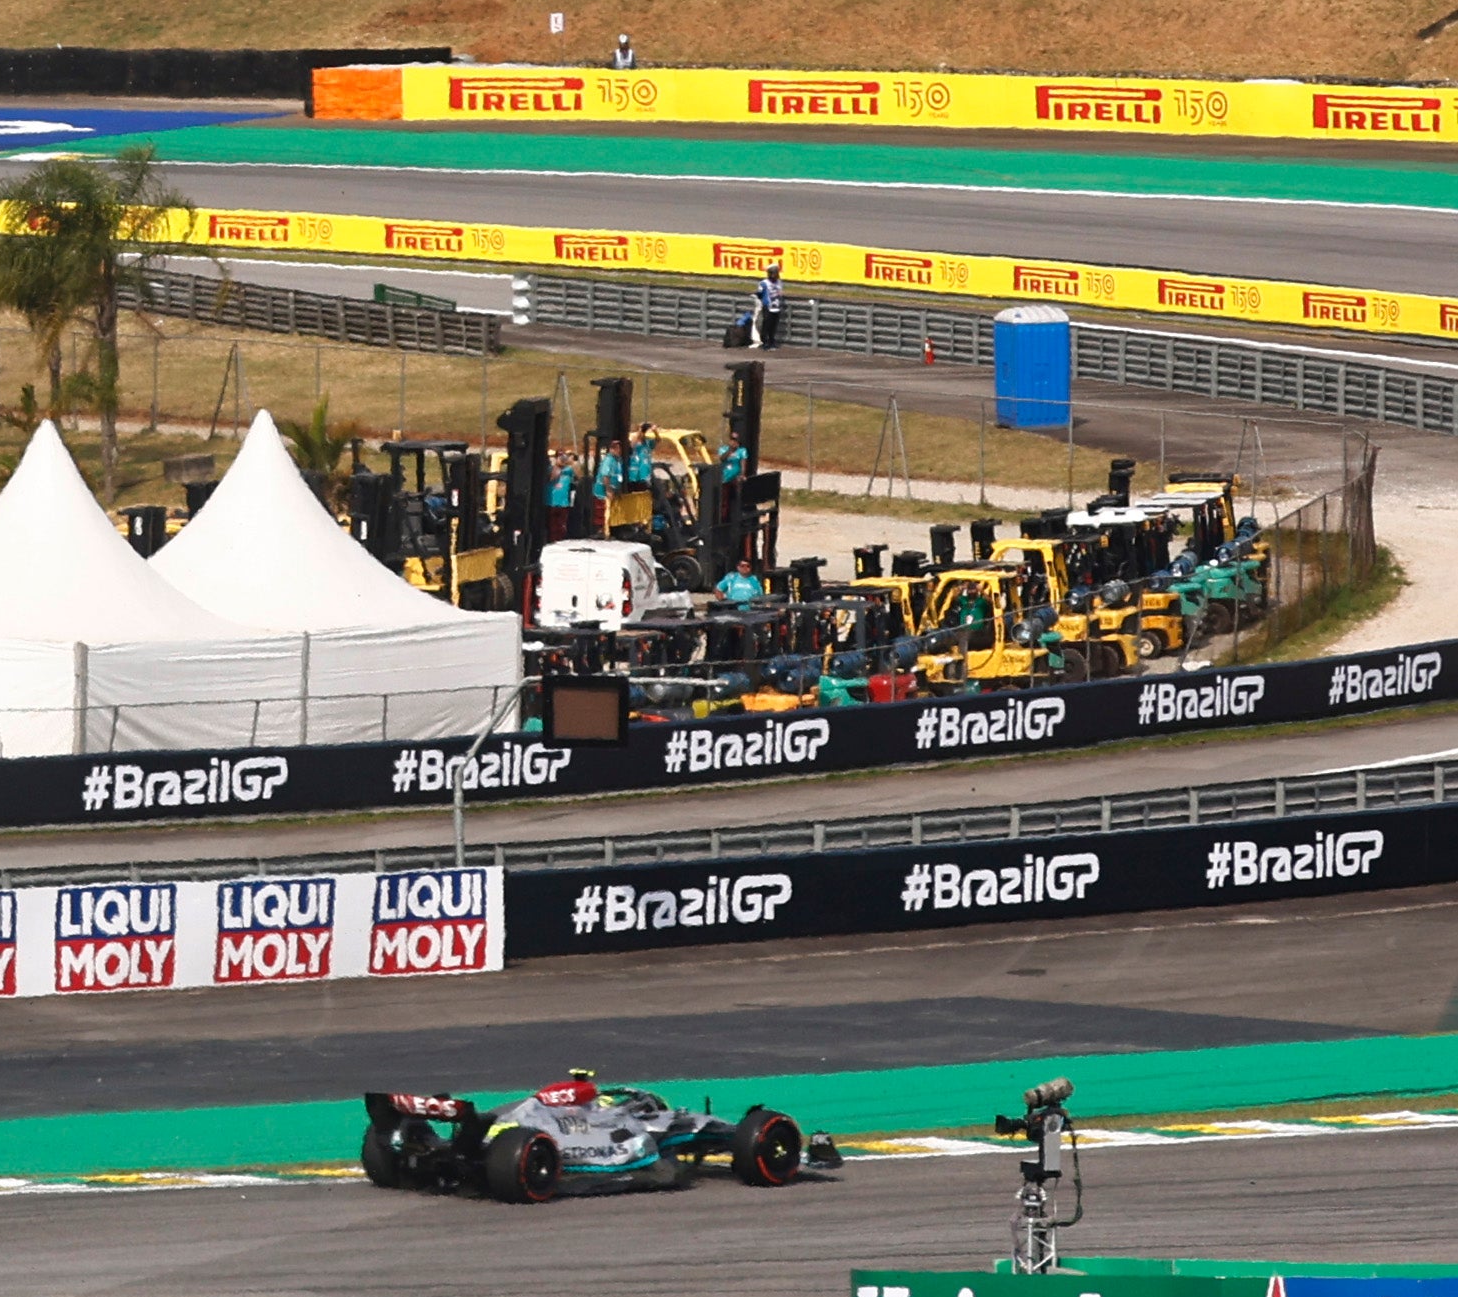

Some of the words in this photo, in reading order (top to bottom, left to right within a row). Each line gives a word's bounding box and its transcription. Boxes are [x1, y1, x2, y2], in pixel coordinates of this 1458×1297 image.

[451, 78, 583, 112] PIRELLI
[750, 80, 880, 116] PIRELLI
[1037, 86, 1162, 124] PIRELLI
[209, 215, 288, 241] PIRELLI
[555, 235, 627, 261] PIRELLI
[1014, 266, 1078, 295] PIRELLI
[1159, 280, 1223, 309] PIRELLI
[1303, 292, 1365, 322] PIRELLI
[1138, 675, 1264, 725] #BrazilGP
[1329, 651, 1441, 705] #BrazilGP
[665, 718, 829, 773] #BrazilGP
[916, 697, 1065, 750] #BrazilGP
[83, 756, 288, 810] #BrazilGP
[901, 851, 1099, 912] #BrazilGP
[1206, 829, 1383, 890] #BrazilGP
[60, 888, 171, 936] LIQUI
[374, 872, 482, 920] LIQUI
[573, 872, 792, 935] #BrazilGP
[60, 938, 171, 988] MOLY
[374, 922, 482, 971] MOLY
[561, 1143, 629, 1160] ETRONAS
